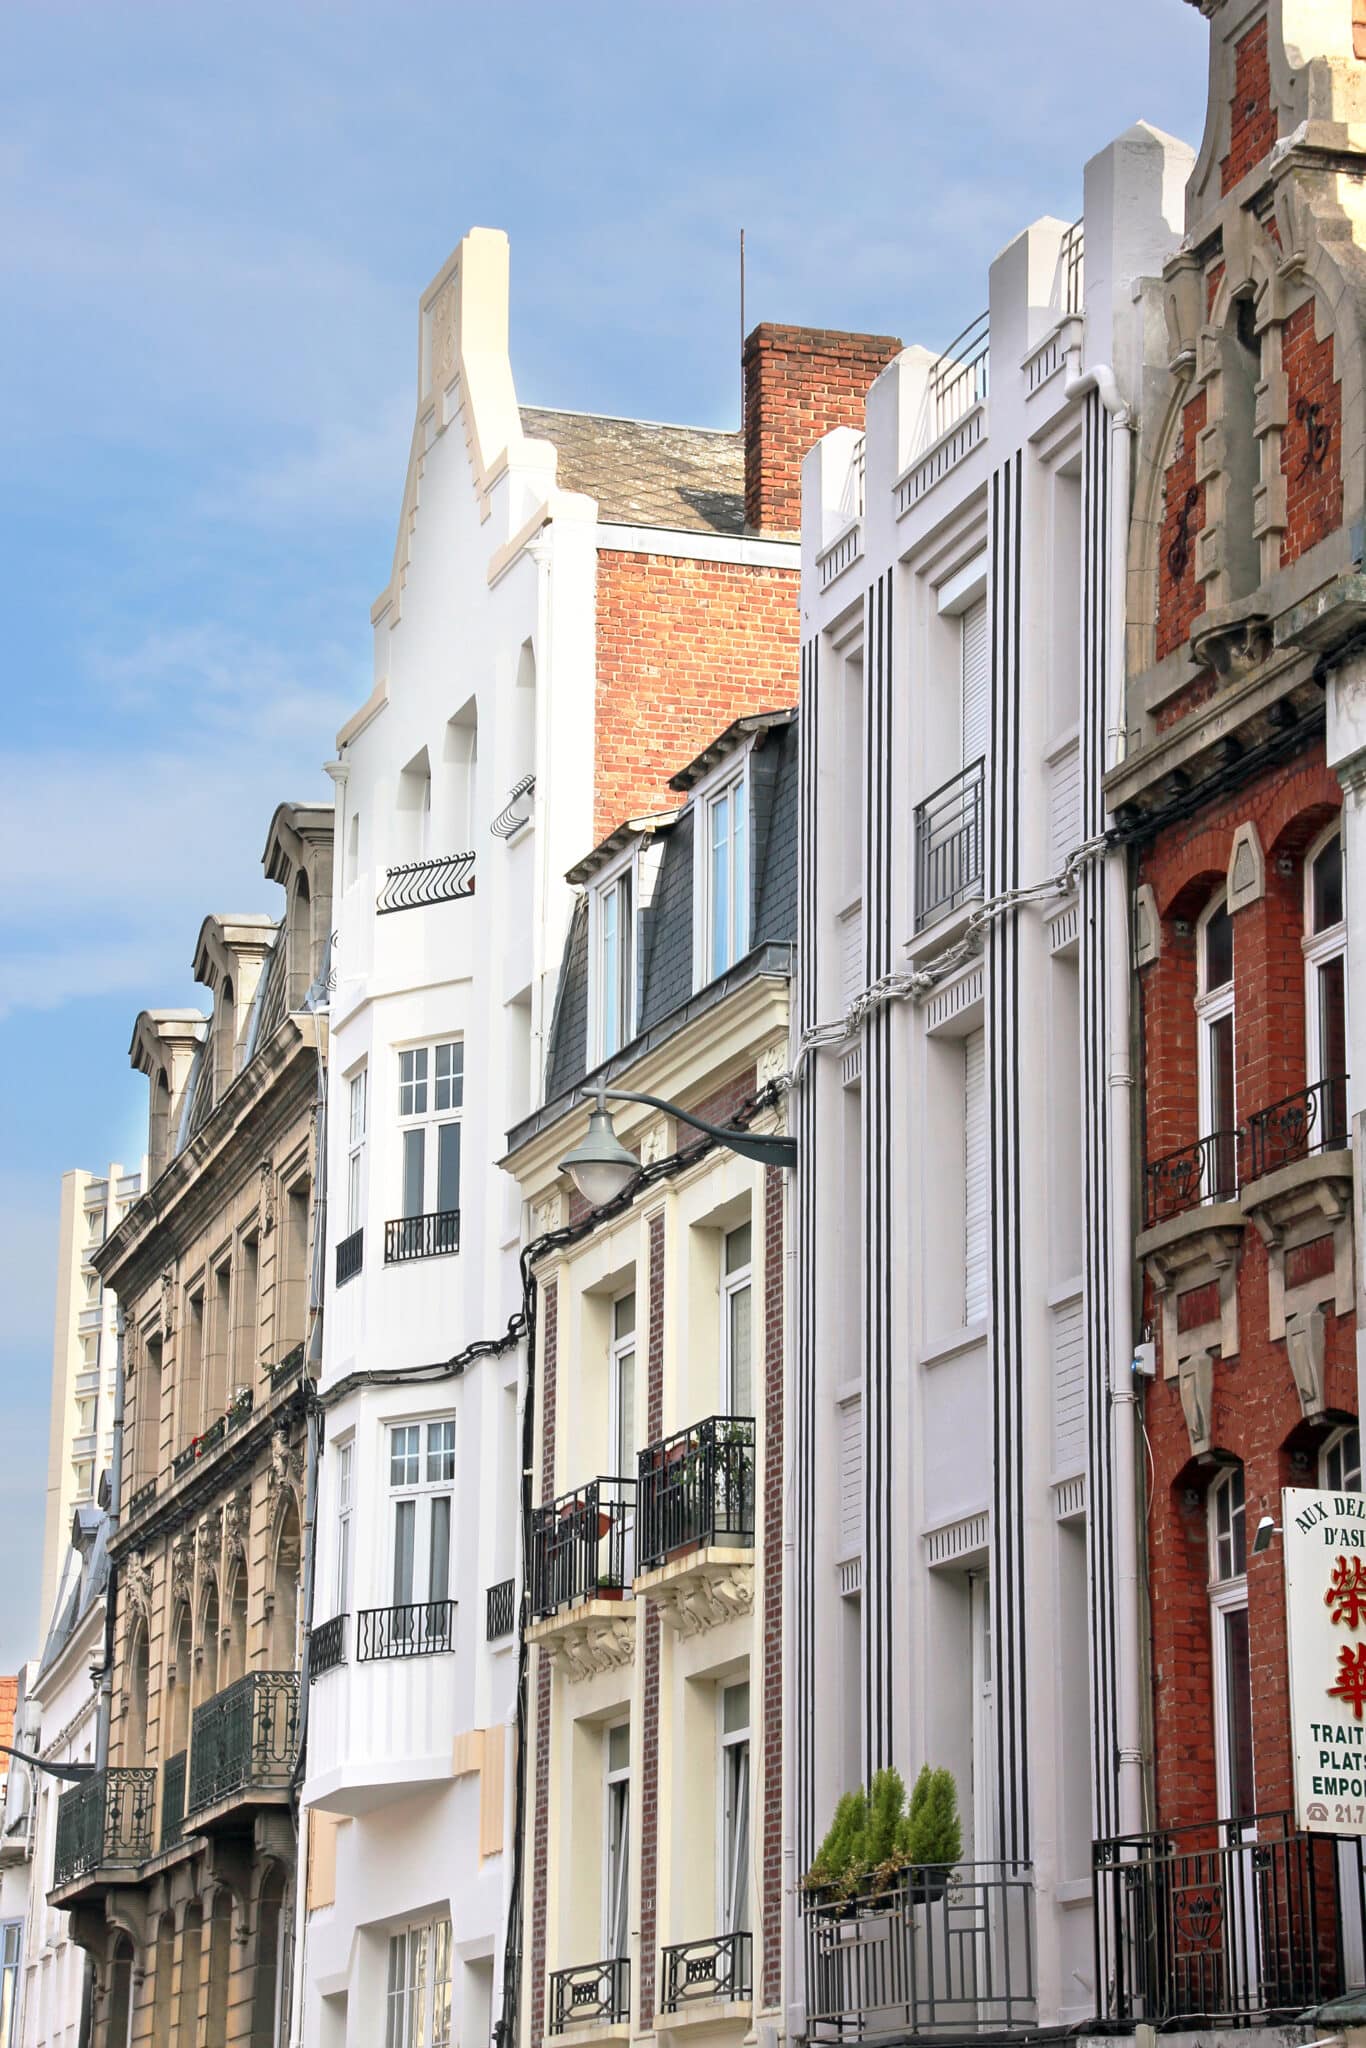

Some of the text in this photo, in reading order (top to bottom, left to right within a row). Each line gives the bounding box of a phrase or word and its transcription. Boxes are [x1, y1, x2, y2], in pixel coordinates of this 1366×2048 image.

[1295, 1501, 1328, 1534] AUX
[1310, 1723, 1366, 1744] TRAIT
[1320, 1750, 1366, 1770] PLAT
[1312, 1776, 1366, 1797] EMPO
